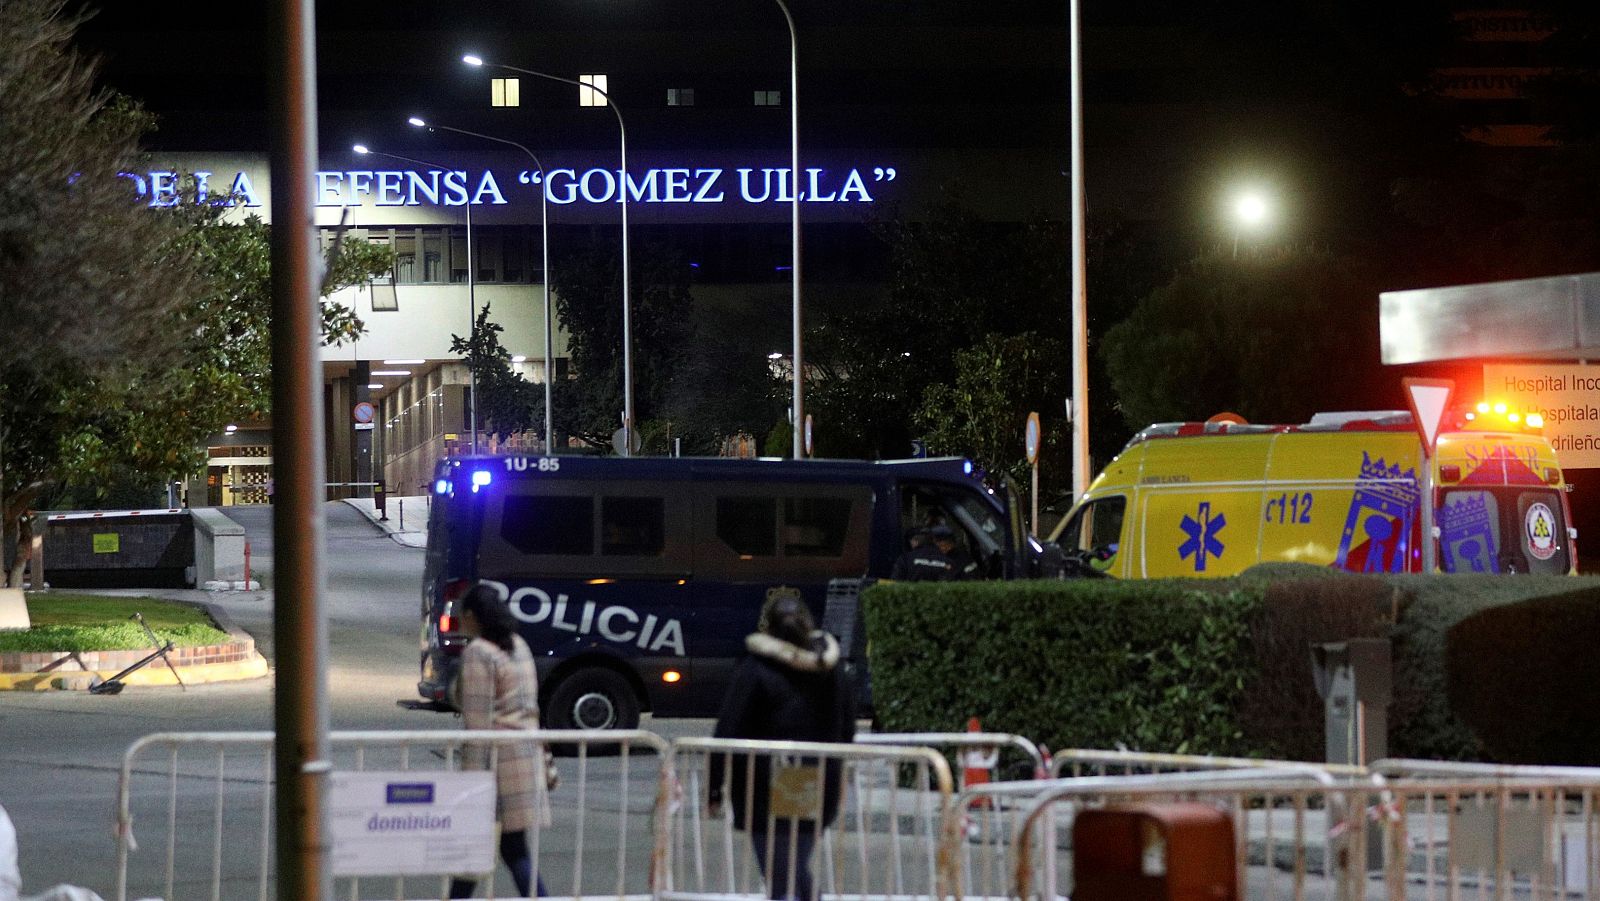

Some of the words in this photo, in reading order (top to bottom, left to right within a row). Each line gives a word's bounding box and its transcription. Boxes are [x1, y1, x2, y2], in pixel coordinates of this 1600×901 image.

[193, 170, 263, 208] LA
[314, 170, 508, 207] EFENSA
[1505, 375, 1567, 395] Hospital
[1551, 434, 1600, 451] drileño
[504, 458, 560, 471] 1U-85
[367, 812, 452, 831] dominion
